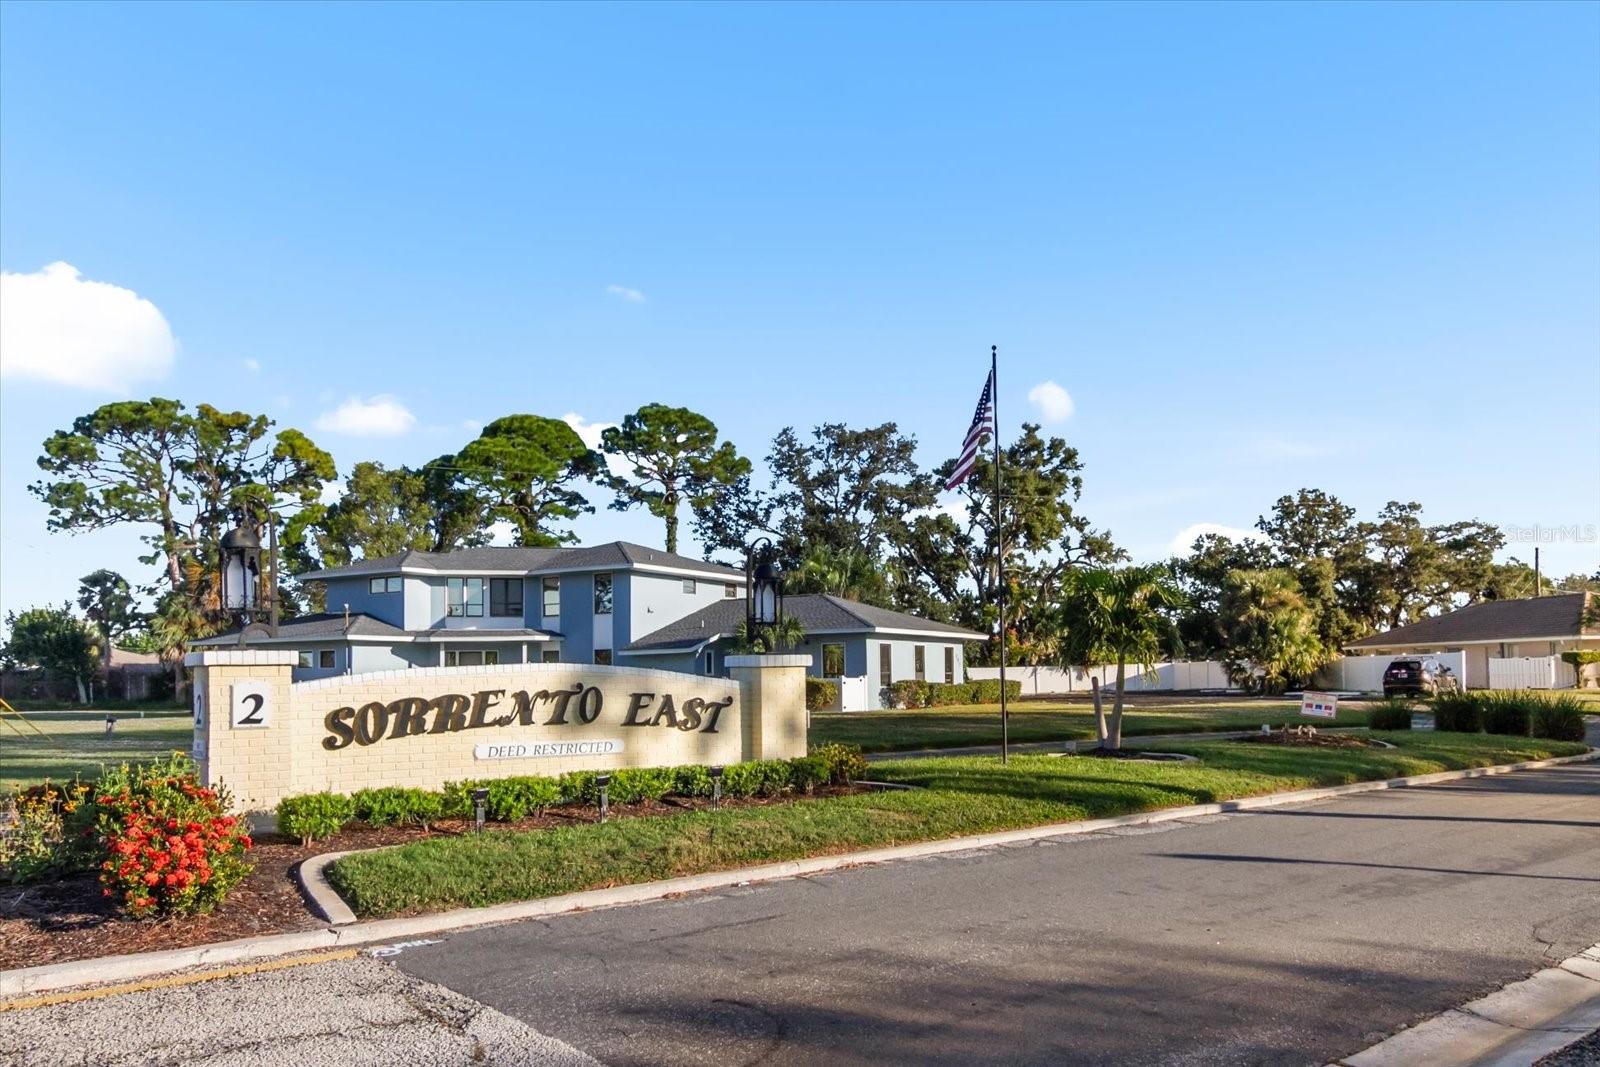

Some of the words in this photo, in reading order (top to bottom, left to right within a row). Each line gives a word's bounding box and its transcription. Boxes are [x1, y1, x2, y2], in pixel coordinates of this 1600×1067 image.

[237, 693, 264, 724] 2
[322, 682, 604, 751] SORRENTO
[620, 692, 734, 734] EAST
[487, 745, 527, 759] DEED
[533, 741, 614, 756] RESTRICTED
